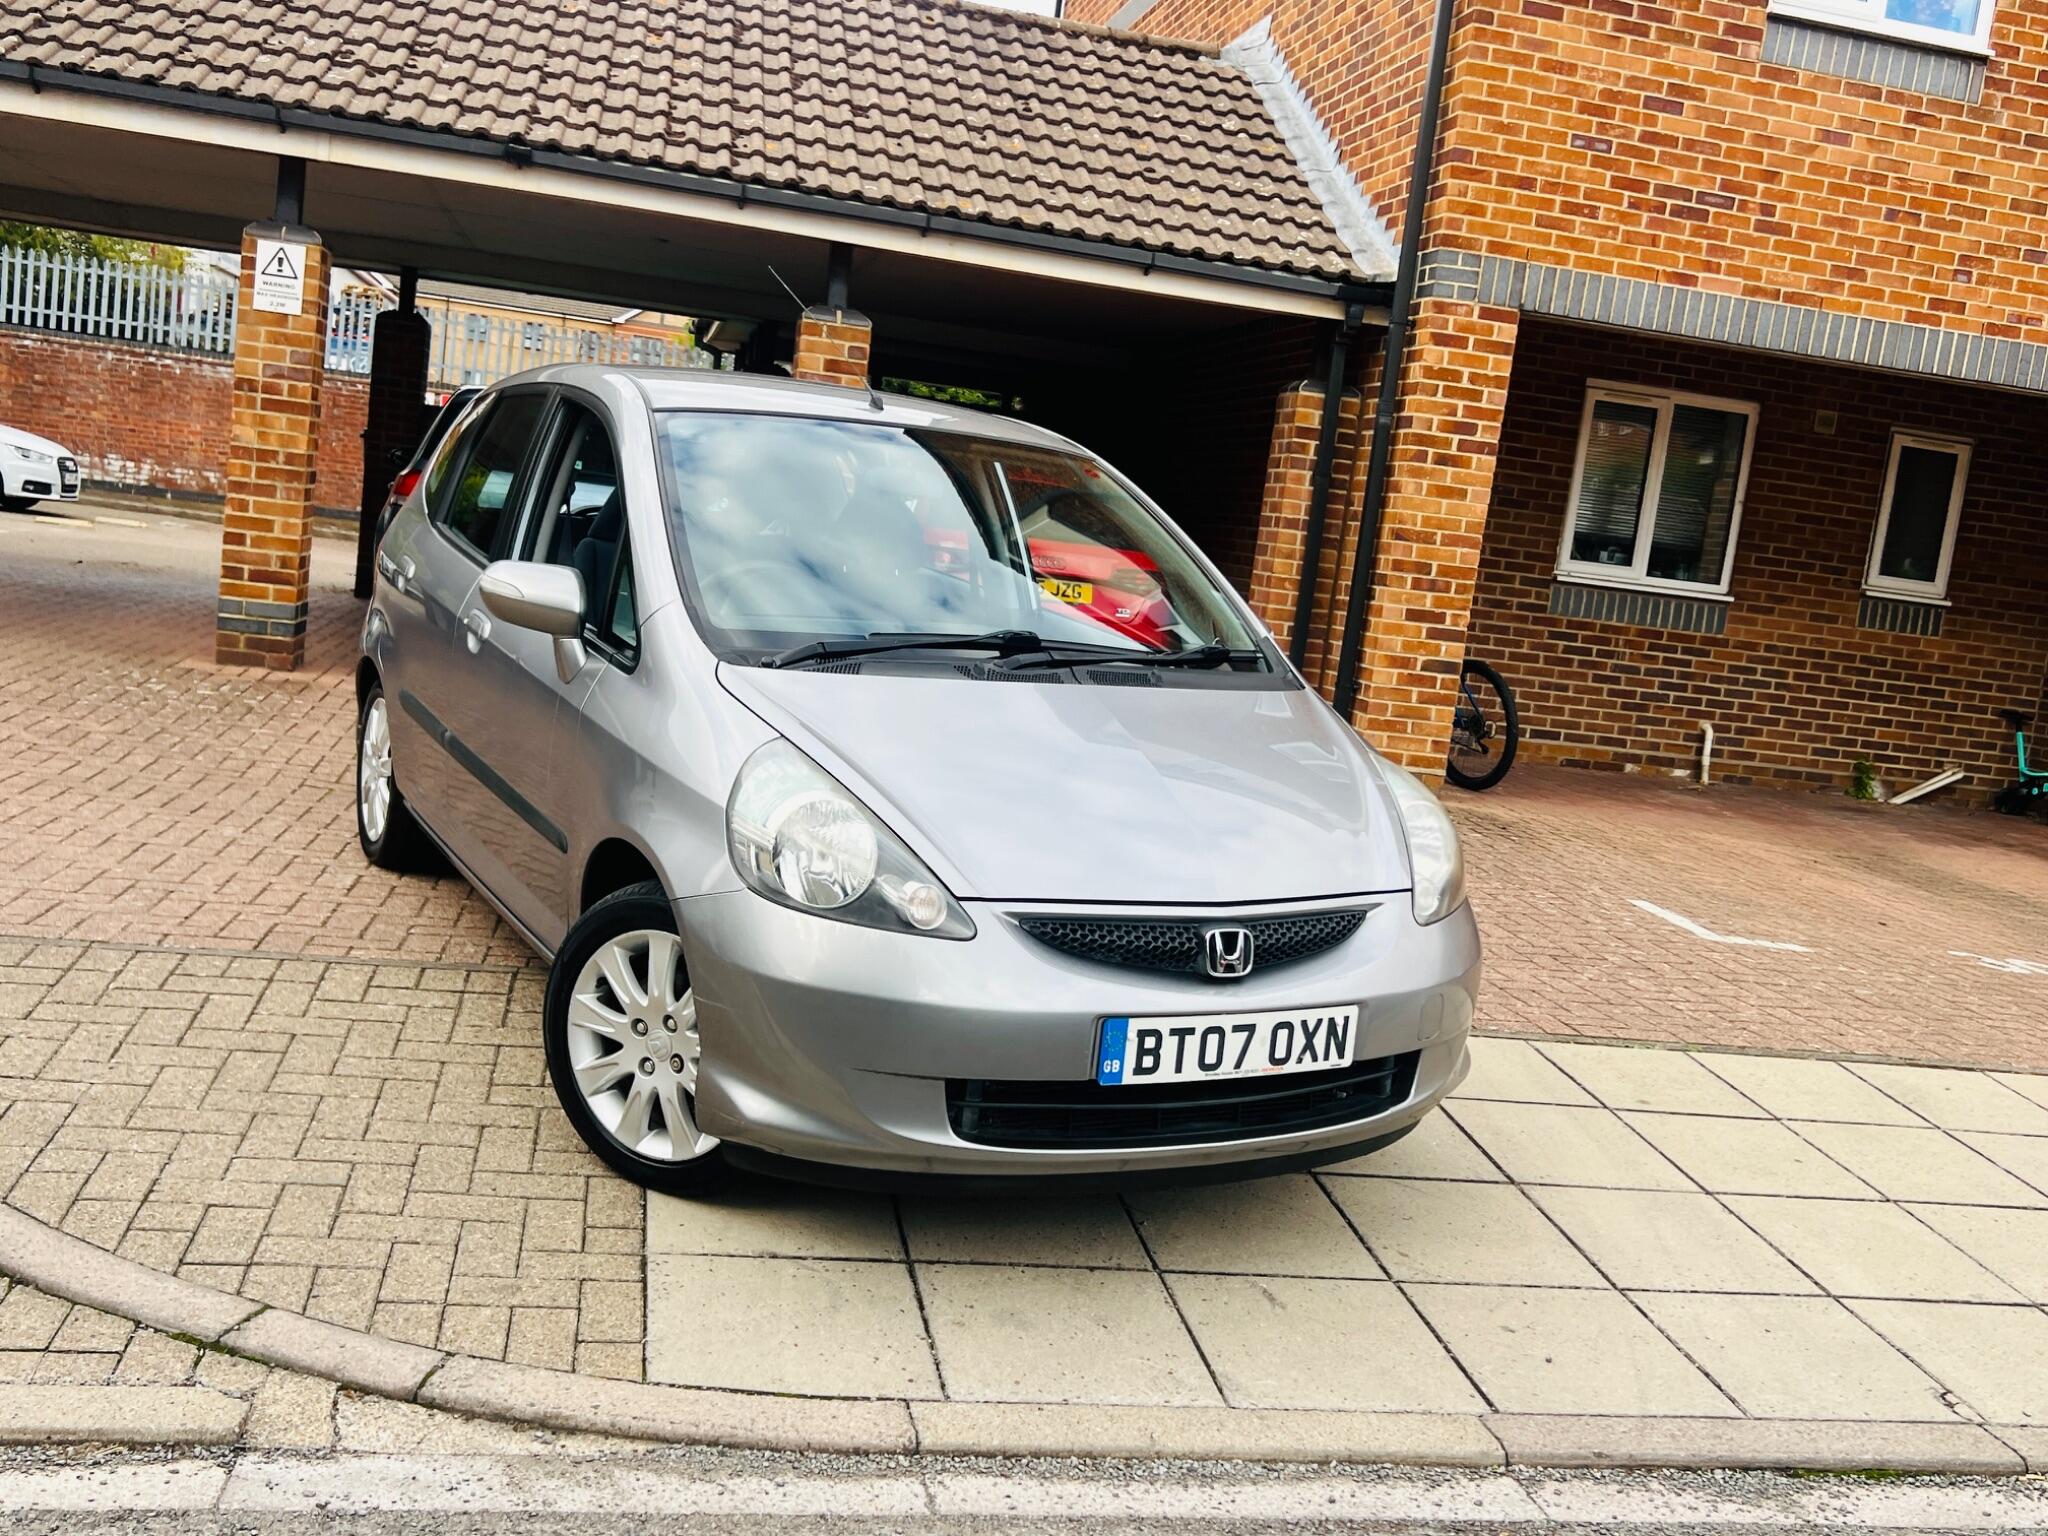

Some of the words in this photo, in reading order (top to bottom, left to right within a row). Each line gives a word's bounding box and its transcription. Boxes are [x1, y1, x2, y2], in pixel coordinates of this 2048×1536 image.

[263, 281, 295, 290] WARNING
[1132, 1023, 1257, 1076] BT07
[1268, 1015, 1350, 1066] OXN
[1103, 1059, 1120, 1073] GB
